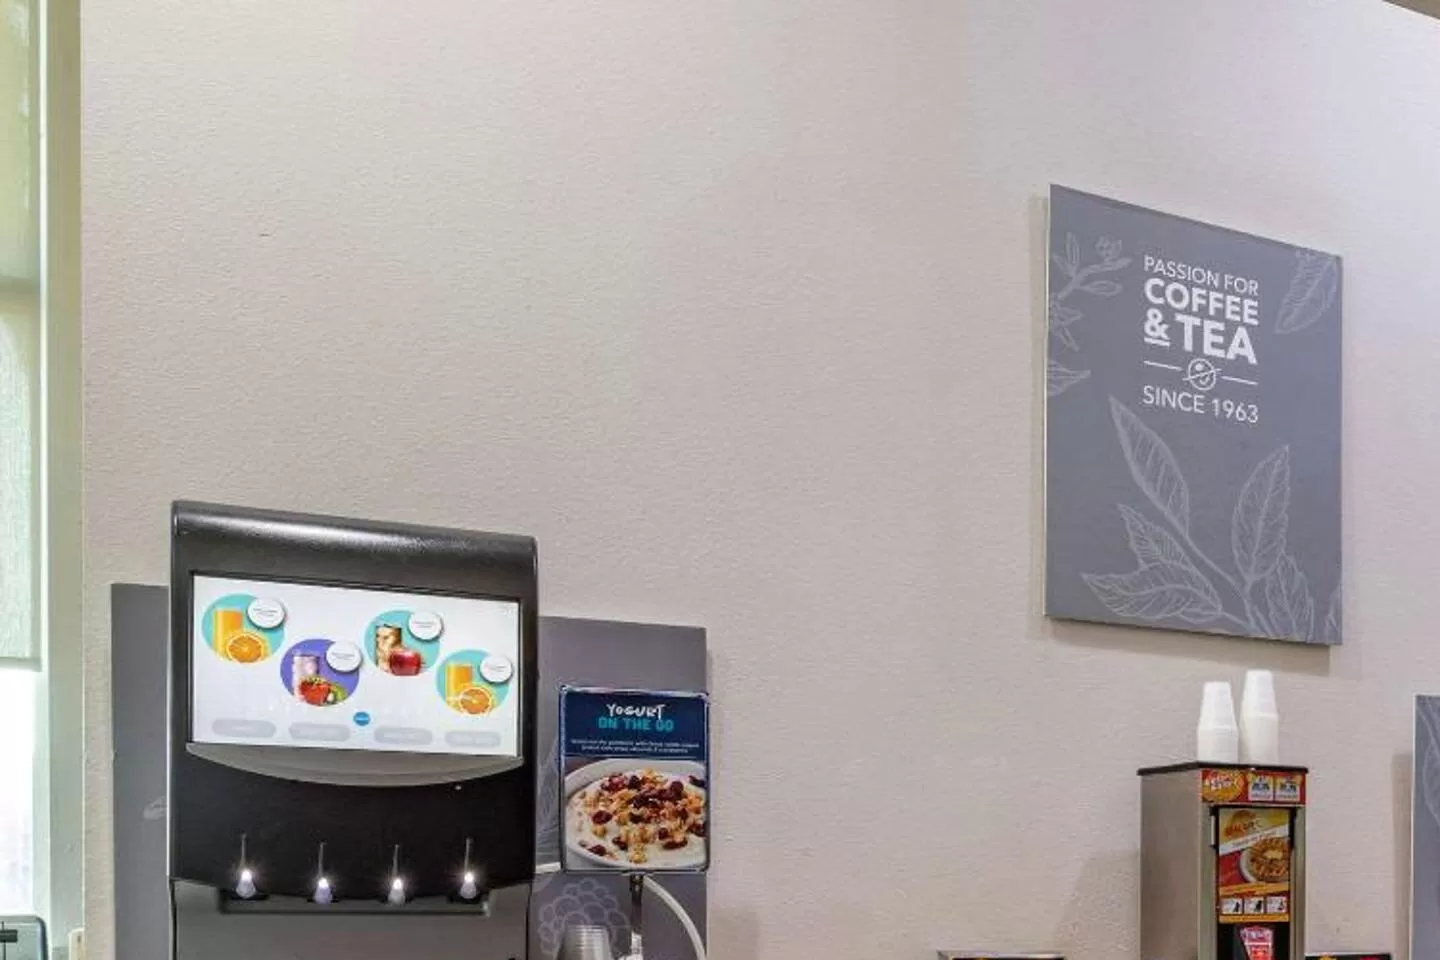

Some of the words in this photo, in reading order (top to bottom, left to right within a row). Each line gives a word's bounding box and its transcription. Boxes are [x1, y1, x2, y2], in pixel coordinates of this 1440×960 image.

[1144, 255, 1220, 288] PASSION
[1224, 274, 1259, 296] FOR
[1144, 277, 1259, 326] COFFEE
[1144, 308, 1170, 341] &
[1175, 313, 1258, 365] TEA
[1143, 385, 1205, 414] SINCE
[1212, 398, 1259, 423] 1963
[598, 716, 618, 729] ON
[621, 718, 651, 731] THE
[606, 703, 666, 720] YOGURT
